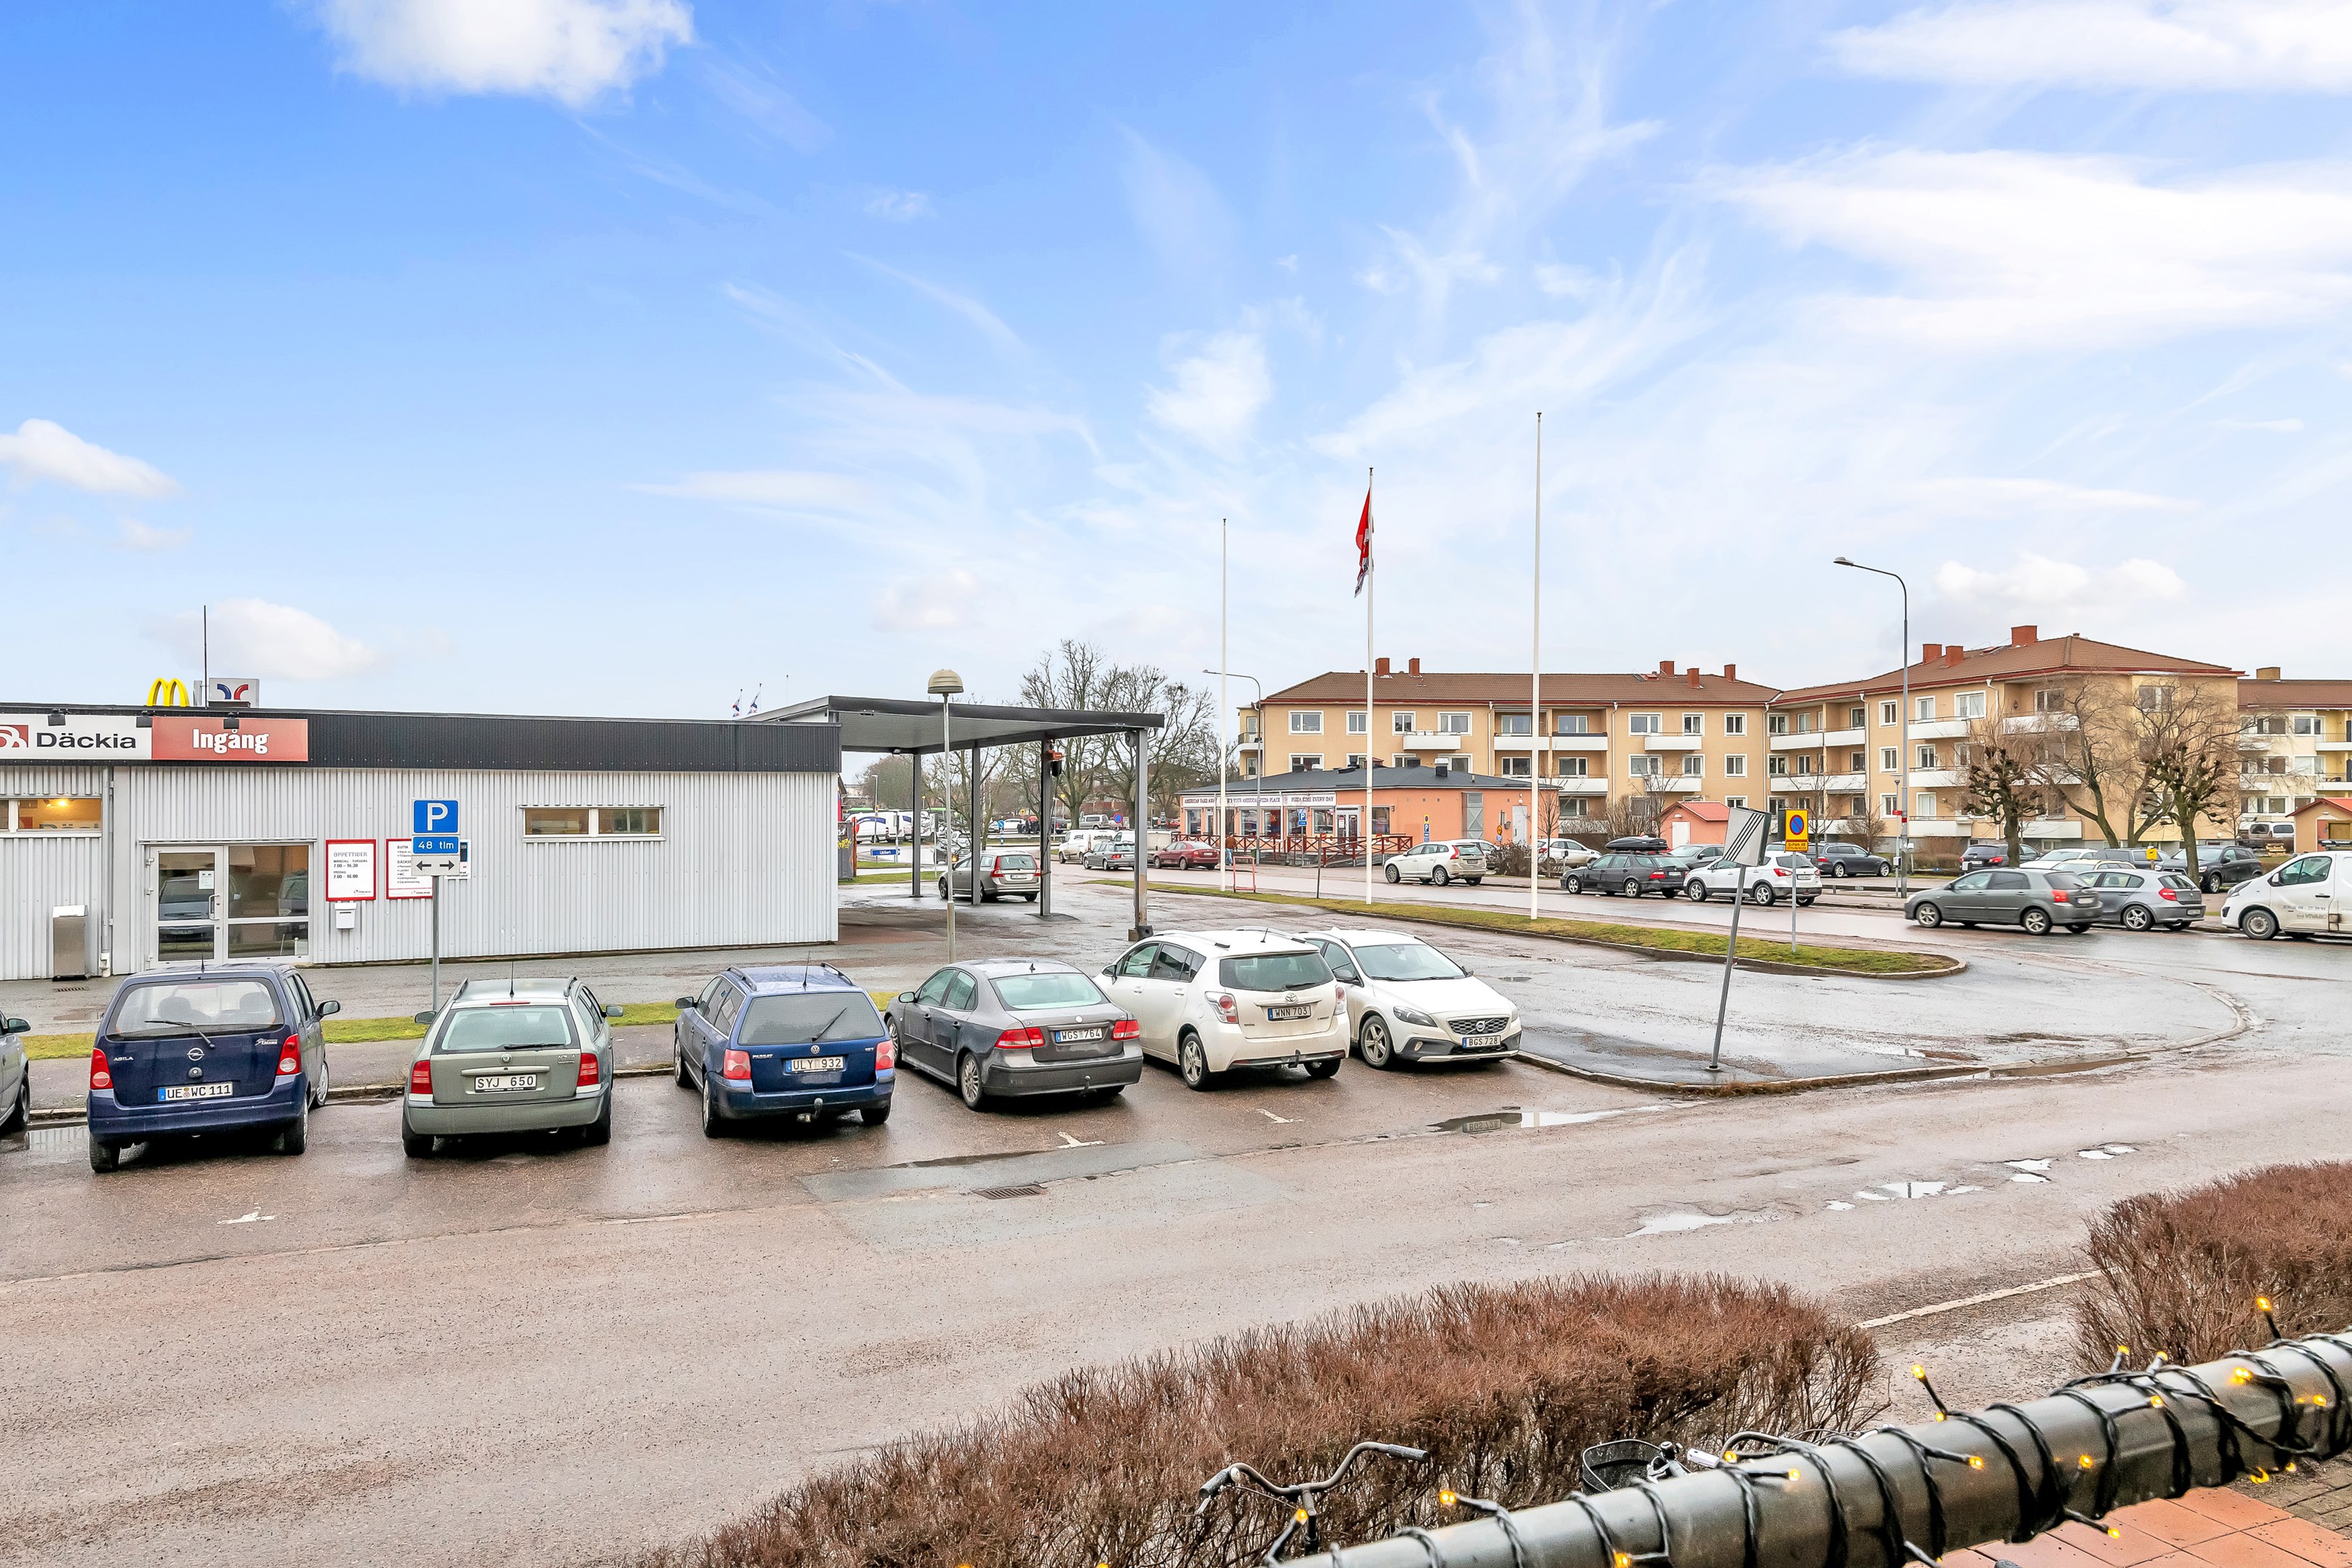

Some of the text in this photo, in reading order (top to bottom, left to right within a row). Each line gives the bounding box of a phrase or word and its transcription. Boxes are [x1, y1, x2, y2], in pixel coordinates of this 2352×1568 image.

[37, 732, 136, 748] Däckia
[192, 728, 269, 754] Ingång
[427, 802, 449, 831] P
[417, 841, 433, 849] 48
[1275, 1007, 1307, 1017] WNN 703
[1061, 1029, 1101, 1040] WGS 764
[1485, 1037, 1498, 1045] 728
[793, 1058, 841, 1070] ULY 932
[478, 1076, 534, 1088] SYJ 650
[167, 1085, 231, 1098] UE WC 111
